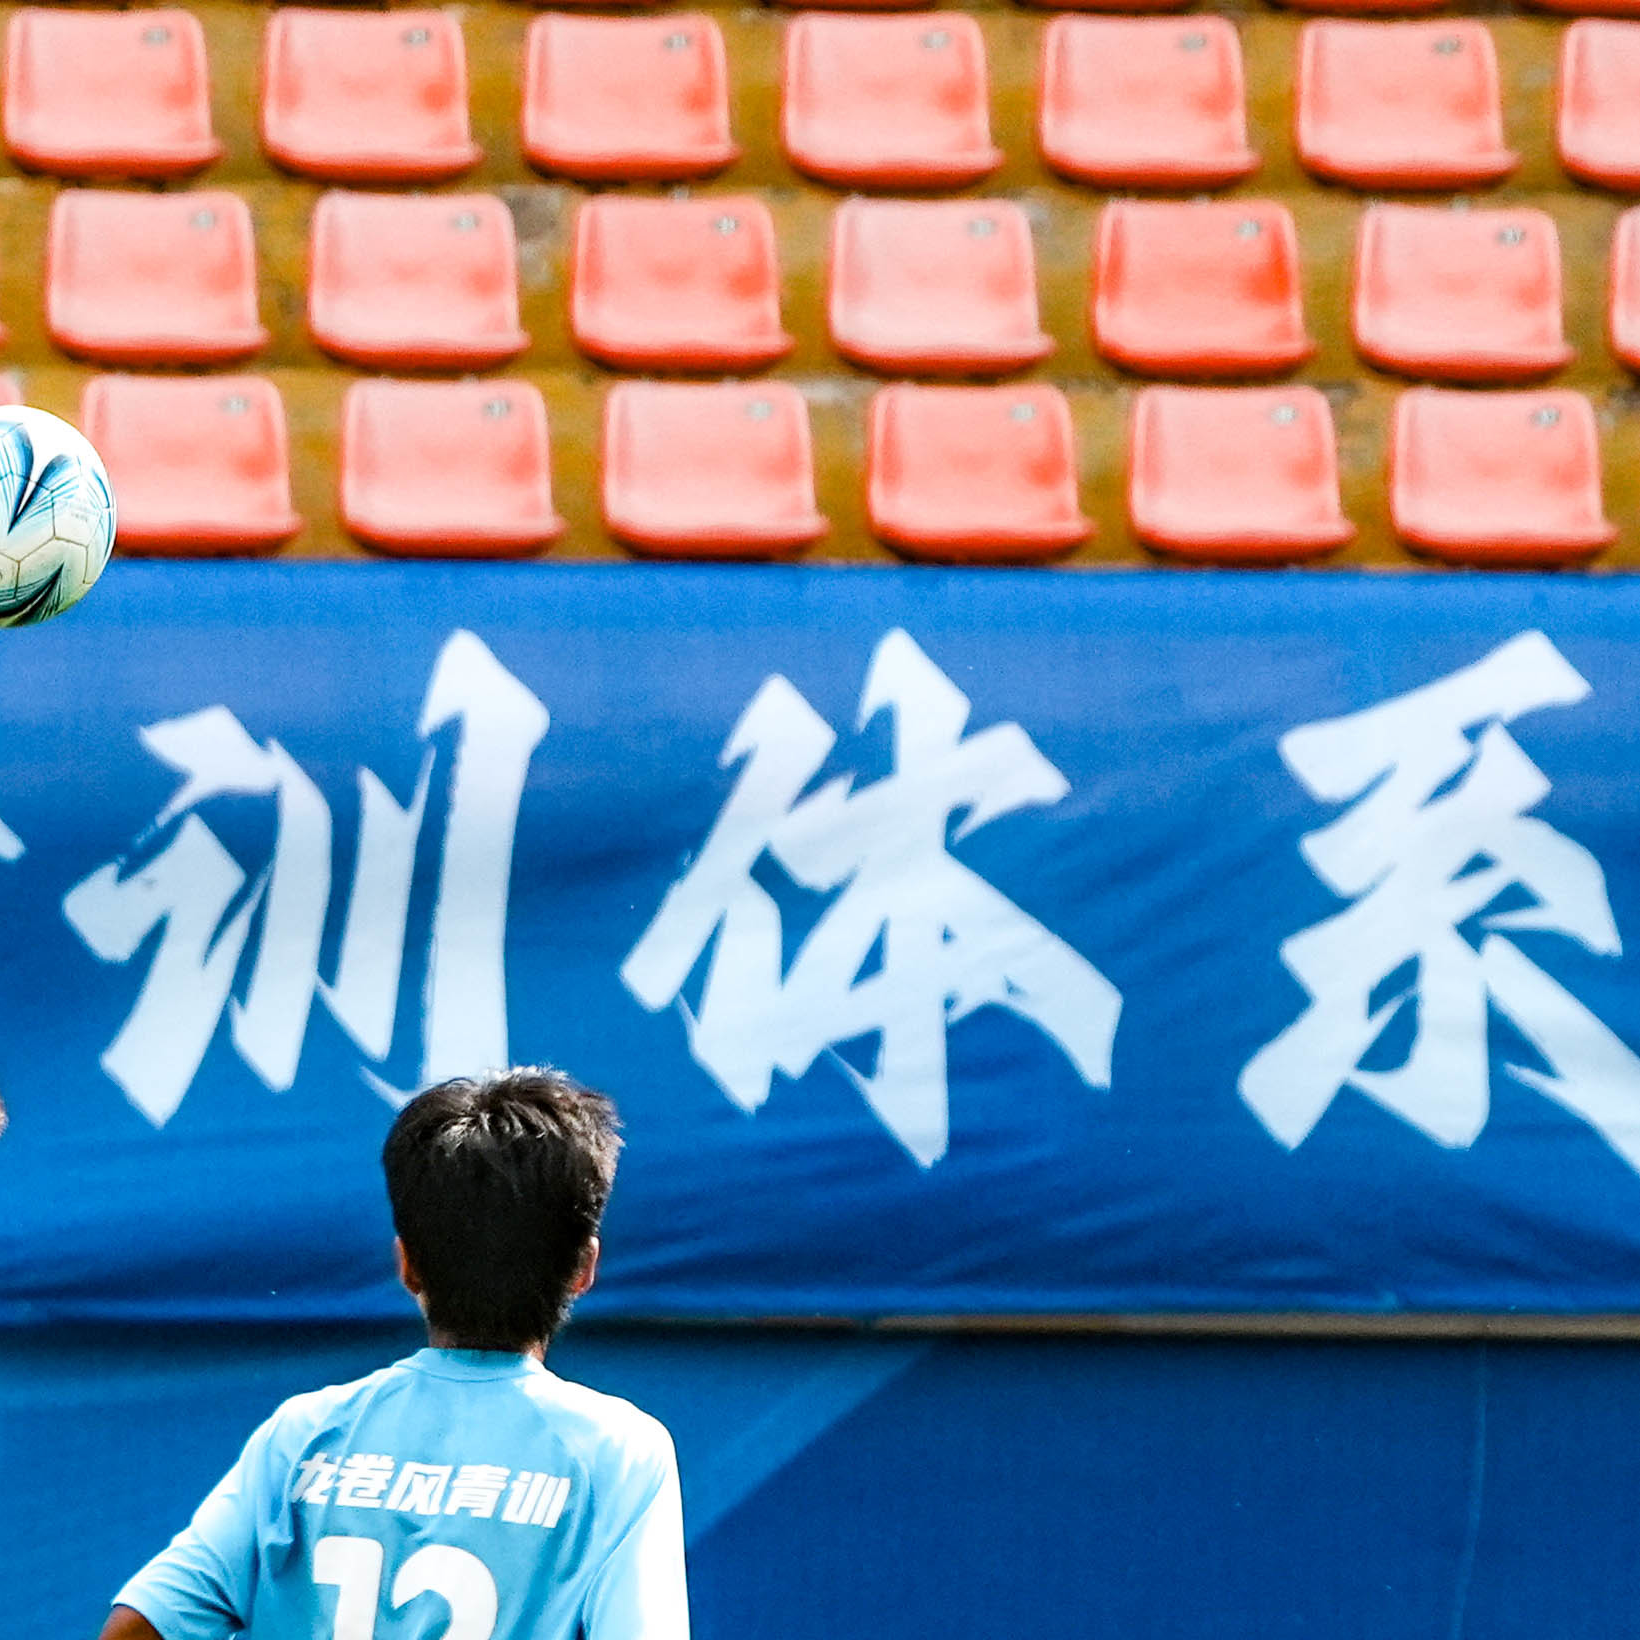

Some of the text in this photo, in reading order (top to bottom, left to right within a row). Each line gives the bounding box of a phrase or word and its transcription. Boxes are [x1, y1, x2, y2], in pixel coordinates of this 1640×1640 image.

[291, 1452, 571, 1528] 龙卷风青训
